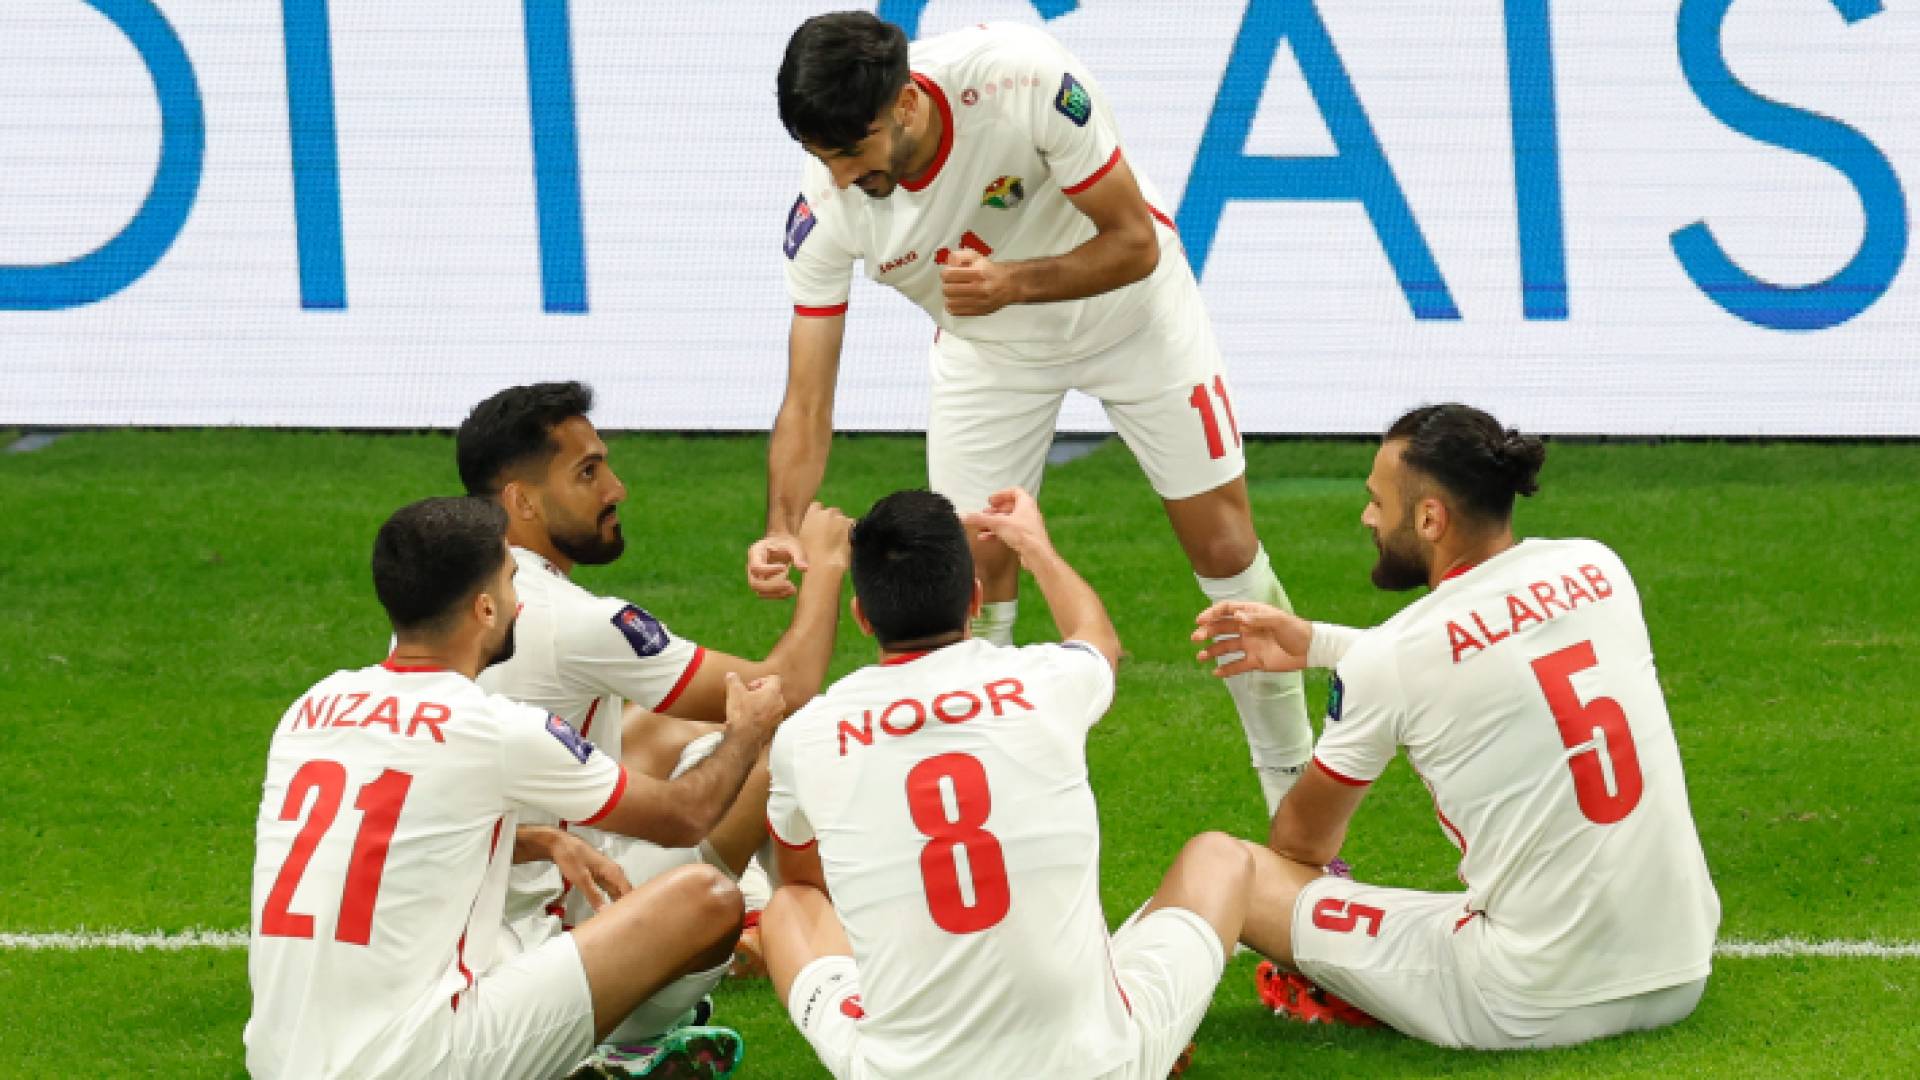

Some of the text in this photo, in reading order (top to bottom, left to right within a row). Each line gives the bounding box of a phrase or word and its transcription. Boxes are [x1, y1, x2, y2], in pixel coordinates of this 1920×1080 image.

[1189, 374, 1241, 460] 11
[1445, 563, 1614, 664] ALARAB
[291, 691, 453, 744] NIZAR
[836, 677, 1035, 757] NOOR
[1530, 639, 1645, 826] 5
[259, 758, 414, 947] 21
[905, 751, 1012, 936] 8
[1311, 897, 1386, 938] 5
